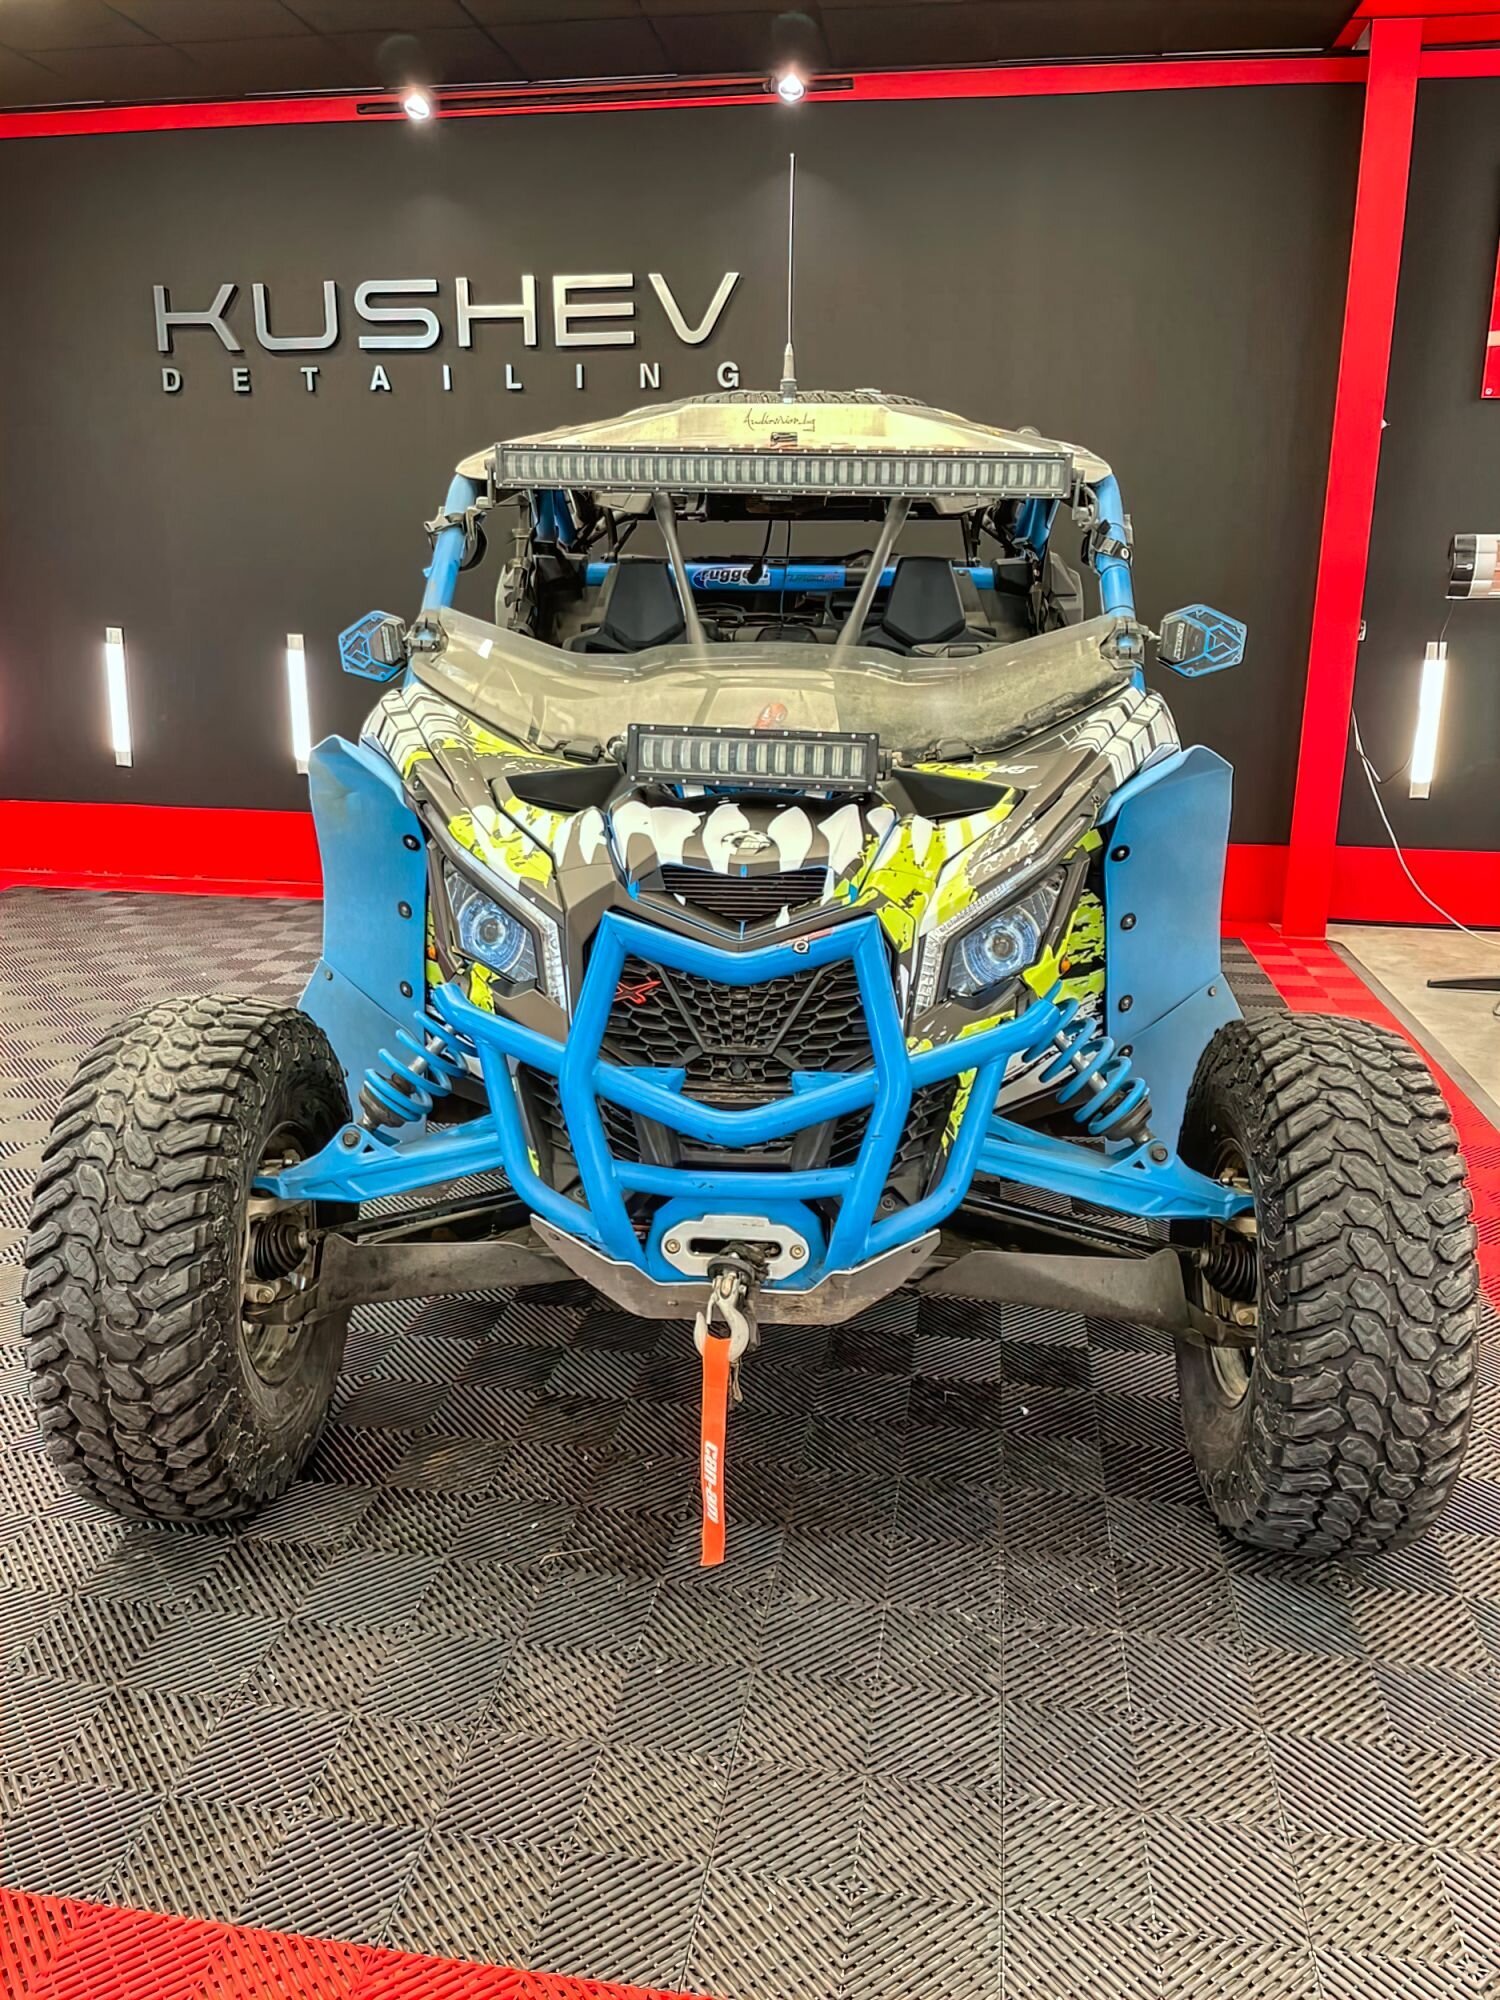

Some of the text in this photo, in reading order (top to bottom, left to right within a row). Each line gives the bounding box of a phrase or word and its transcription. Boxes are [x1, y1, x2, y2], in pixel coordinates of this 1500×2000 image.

[153, 272, 740, 353] KUSHEV
[161, 361, 740, 392] DETAILING
[700, 567, 769, 583] rugge
